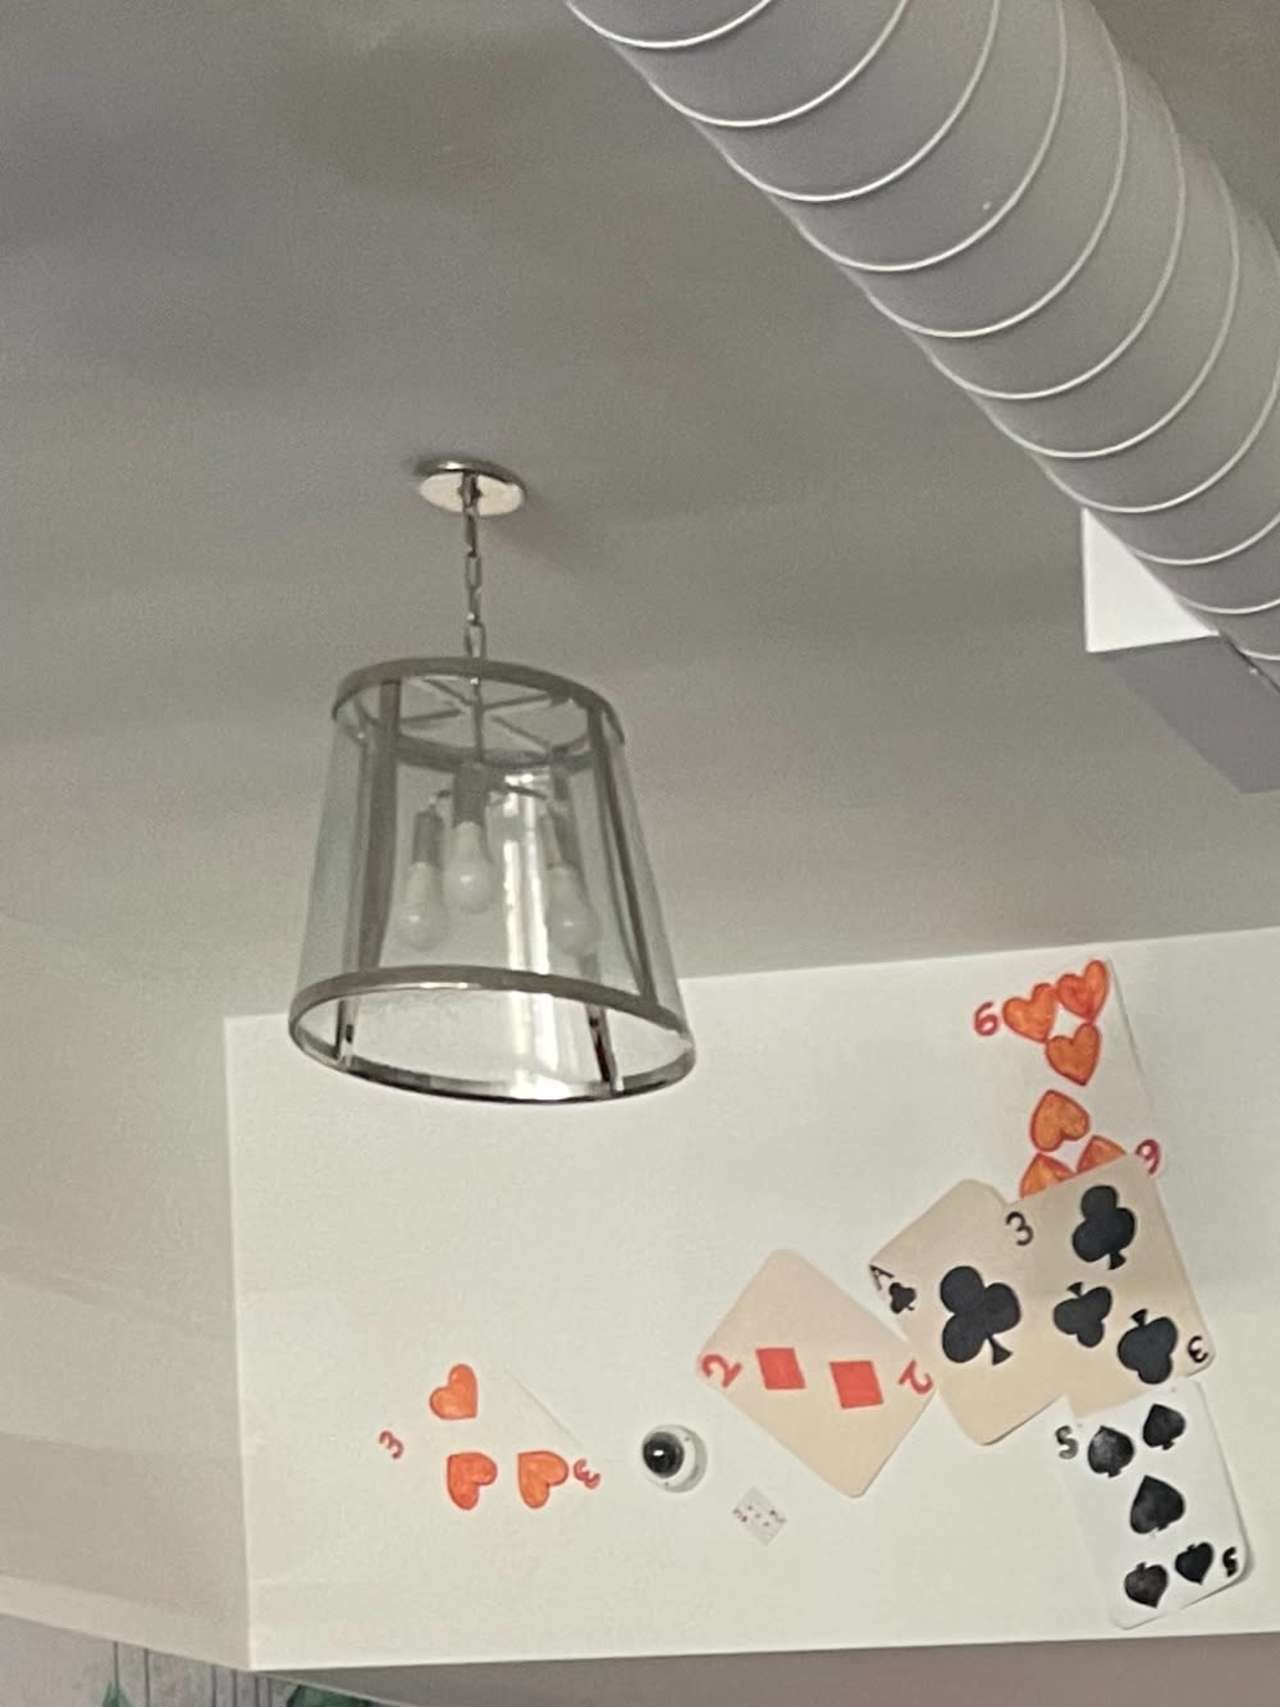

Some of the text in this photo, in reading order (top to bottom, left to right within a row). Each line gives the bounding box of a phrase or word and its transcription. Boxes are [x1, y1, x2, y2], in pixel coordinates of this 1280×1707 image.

[973, 1002, 999, 1036] 6
[1005, 1211, 1034, 1246] 3
[869, 1264, 896, 1291] A
[1187, 1335, 1209, 1363] 3
[701, 1353, 743, 1389] 2
[897, 1359, 934, 1395] 2
[378, 1430, 405, 1460] 3
[1055, 1424, 1079, 1460] 5
[572, 1457, 601, 1490] 3
[1221, 1545, 1239, 1577] 5
